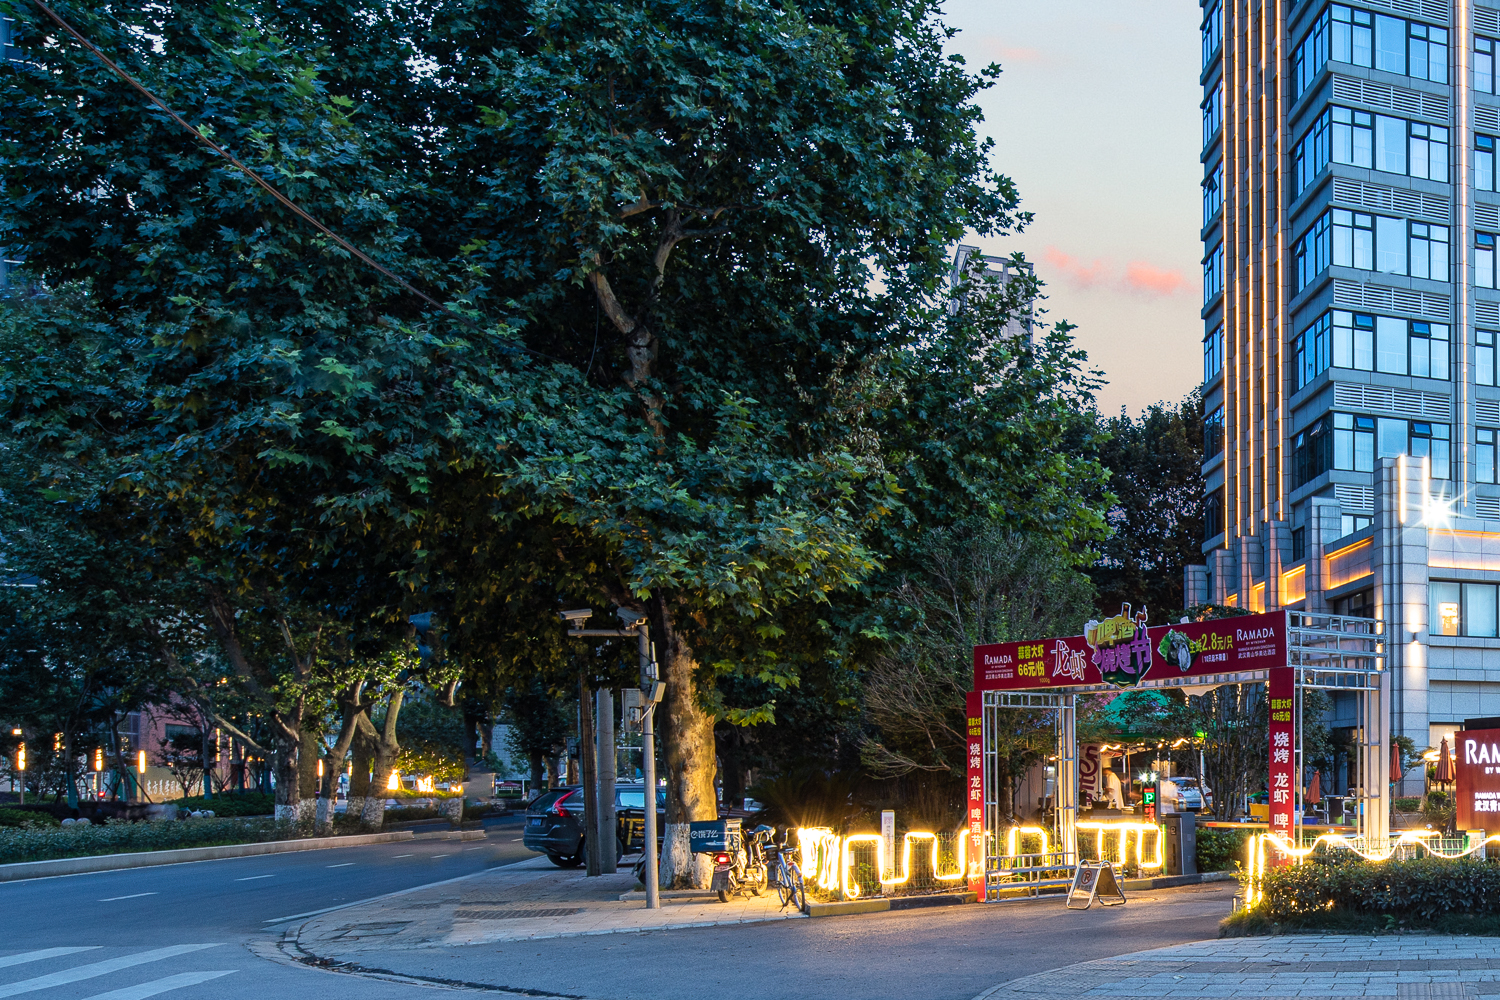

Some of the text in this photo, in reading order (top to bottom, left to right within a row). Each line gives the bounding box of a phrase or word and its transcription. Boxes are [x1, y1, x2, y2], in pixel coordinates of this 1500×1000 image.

[1236, 627, 1275, 642] RAMADA
[984, 654, 1013, 665] RAMADA
[1050, 639, 1087, 681] 龙虾
[1273, 732, 1290, 764] 烧烤
[1485, 766, 1494, 774] BY
[969, 743, 982, 847] 烧烤 龙虾 啤酒节
[1273, 772, 1289, 804] 龙虾
